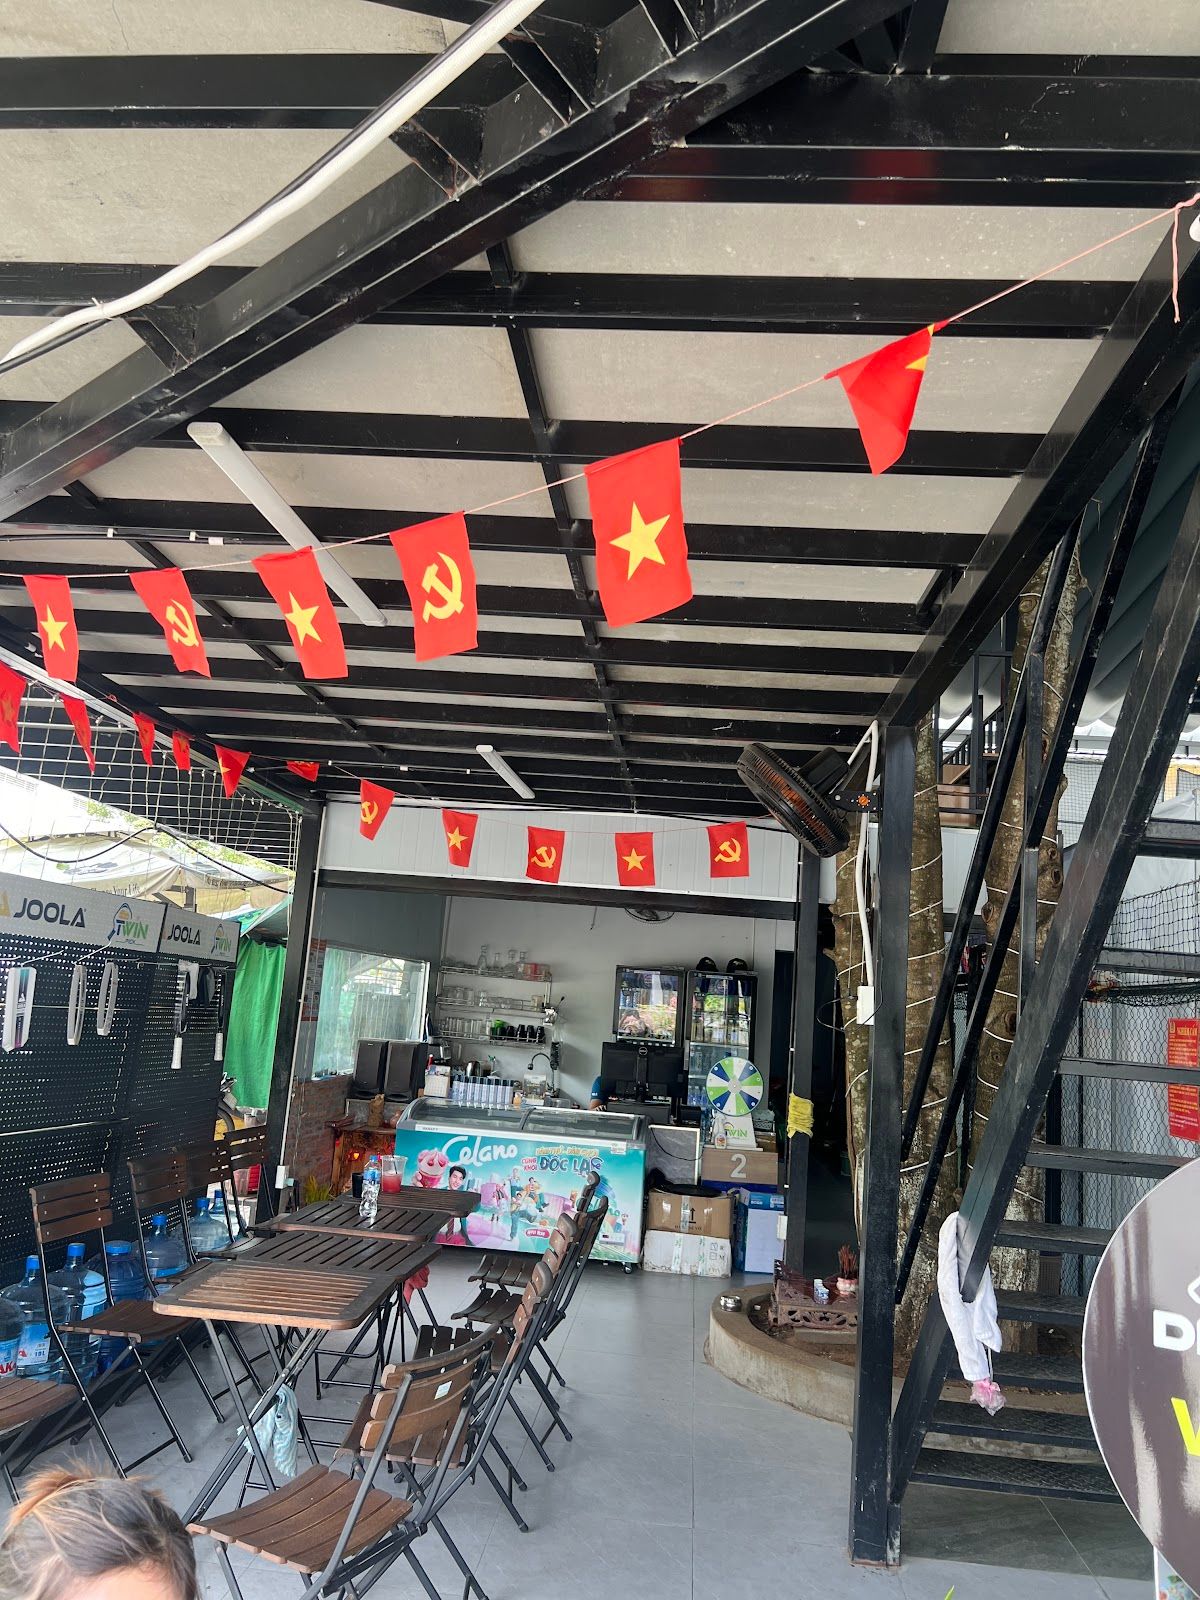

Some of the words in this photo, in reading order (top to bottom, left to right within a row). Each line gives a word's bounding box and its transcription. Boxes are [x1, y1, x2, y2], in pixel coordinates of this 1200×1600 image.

[13, 897, 86, 928] JOOLA
[115, 919, 149, 940] TWIN
[167, 923, 201, 946] JOOLA
[438, 1135, 518, 1167] Celano
[730, 1154, 747, 1179] 2
[1153, 1309, 1200, 1356] D
